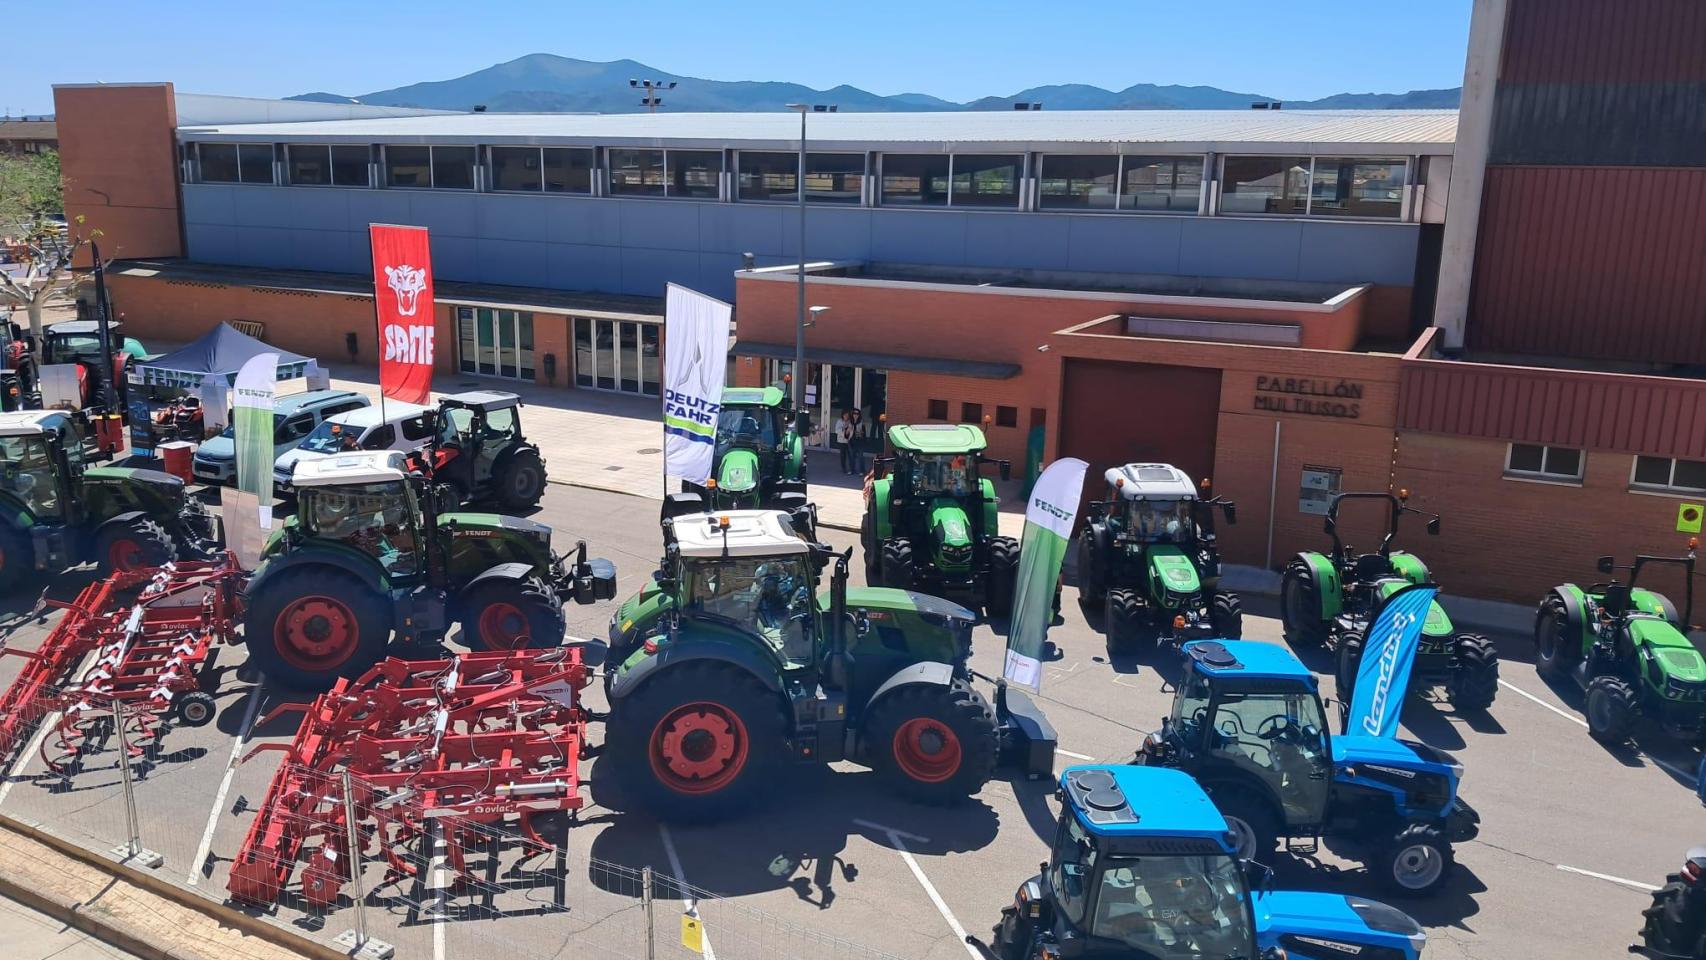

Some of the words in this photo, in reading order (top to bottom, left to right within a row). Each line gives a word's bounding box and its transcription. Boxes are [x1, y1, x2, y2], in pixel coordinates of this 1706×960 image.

[385, 324, 434, 365] SAME
[144, 367, 204, 388] FENDT
[1256, 376, 1363, 399] PABELLÓN
[238, 388, 273, 398] FENDT
[666, 389, 719, 414] DEUTZ
[667, 403, 712, 424] FAHR
[1254, 395, 1360, 418] MULTIUSOS
[1035, 498, 1073, 520] FENDT
[485, 804, 510, 814] ovlac
